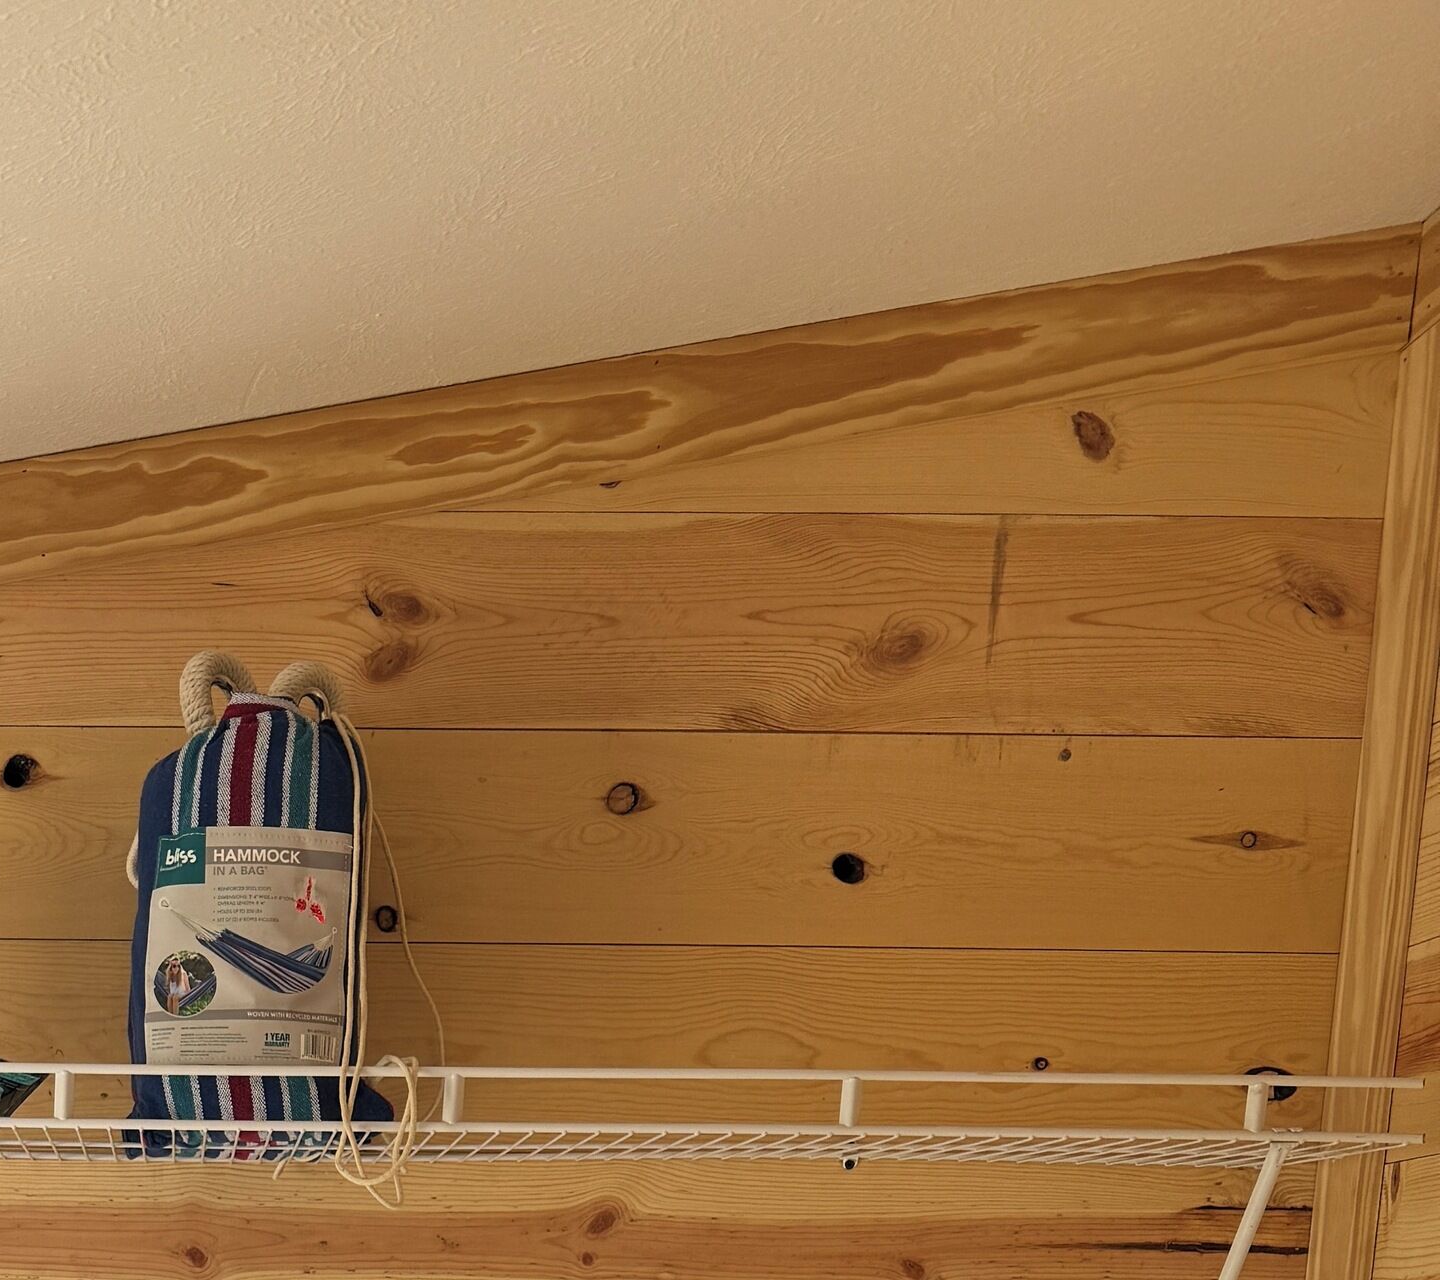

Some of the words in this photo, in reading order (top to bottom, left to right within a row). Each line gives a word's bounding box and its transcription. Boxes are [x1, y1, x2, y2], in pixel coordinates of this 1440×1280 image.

[165, 848, 197, 866] bliss
[213, 849, 301, 864] HAMMOCK
[213, 866, 225, 875] IN
[230, 866, 238, 875] A
[270, 1033, 290, 1042] YEAR
